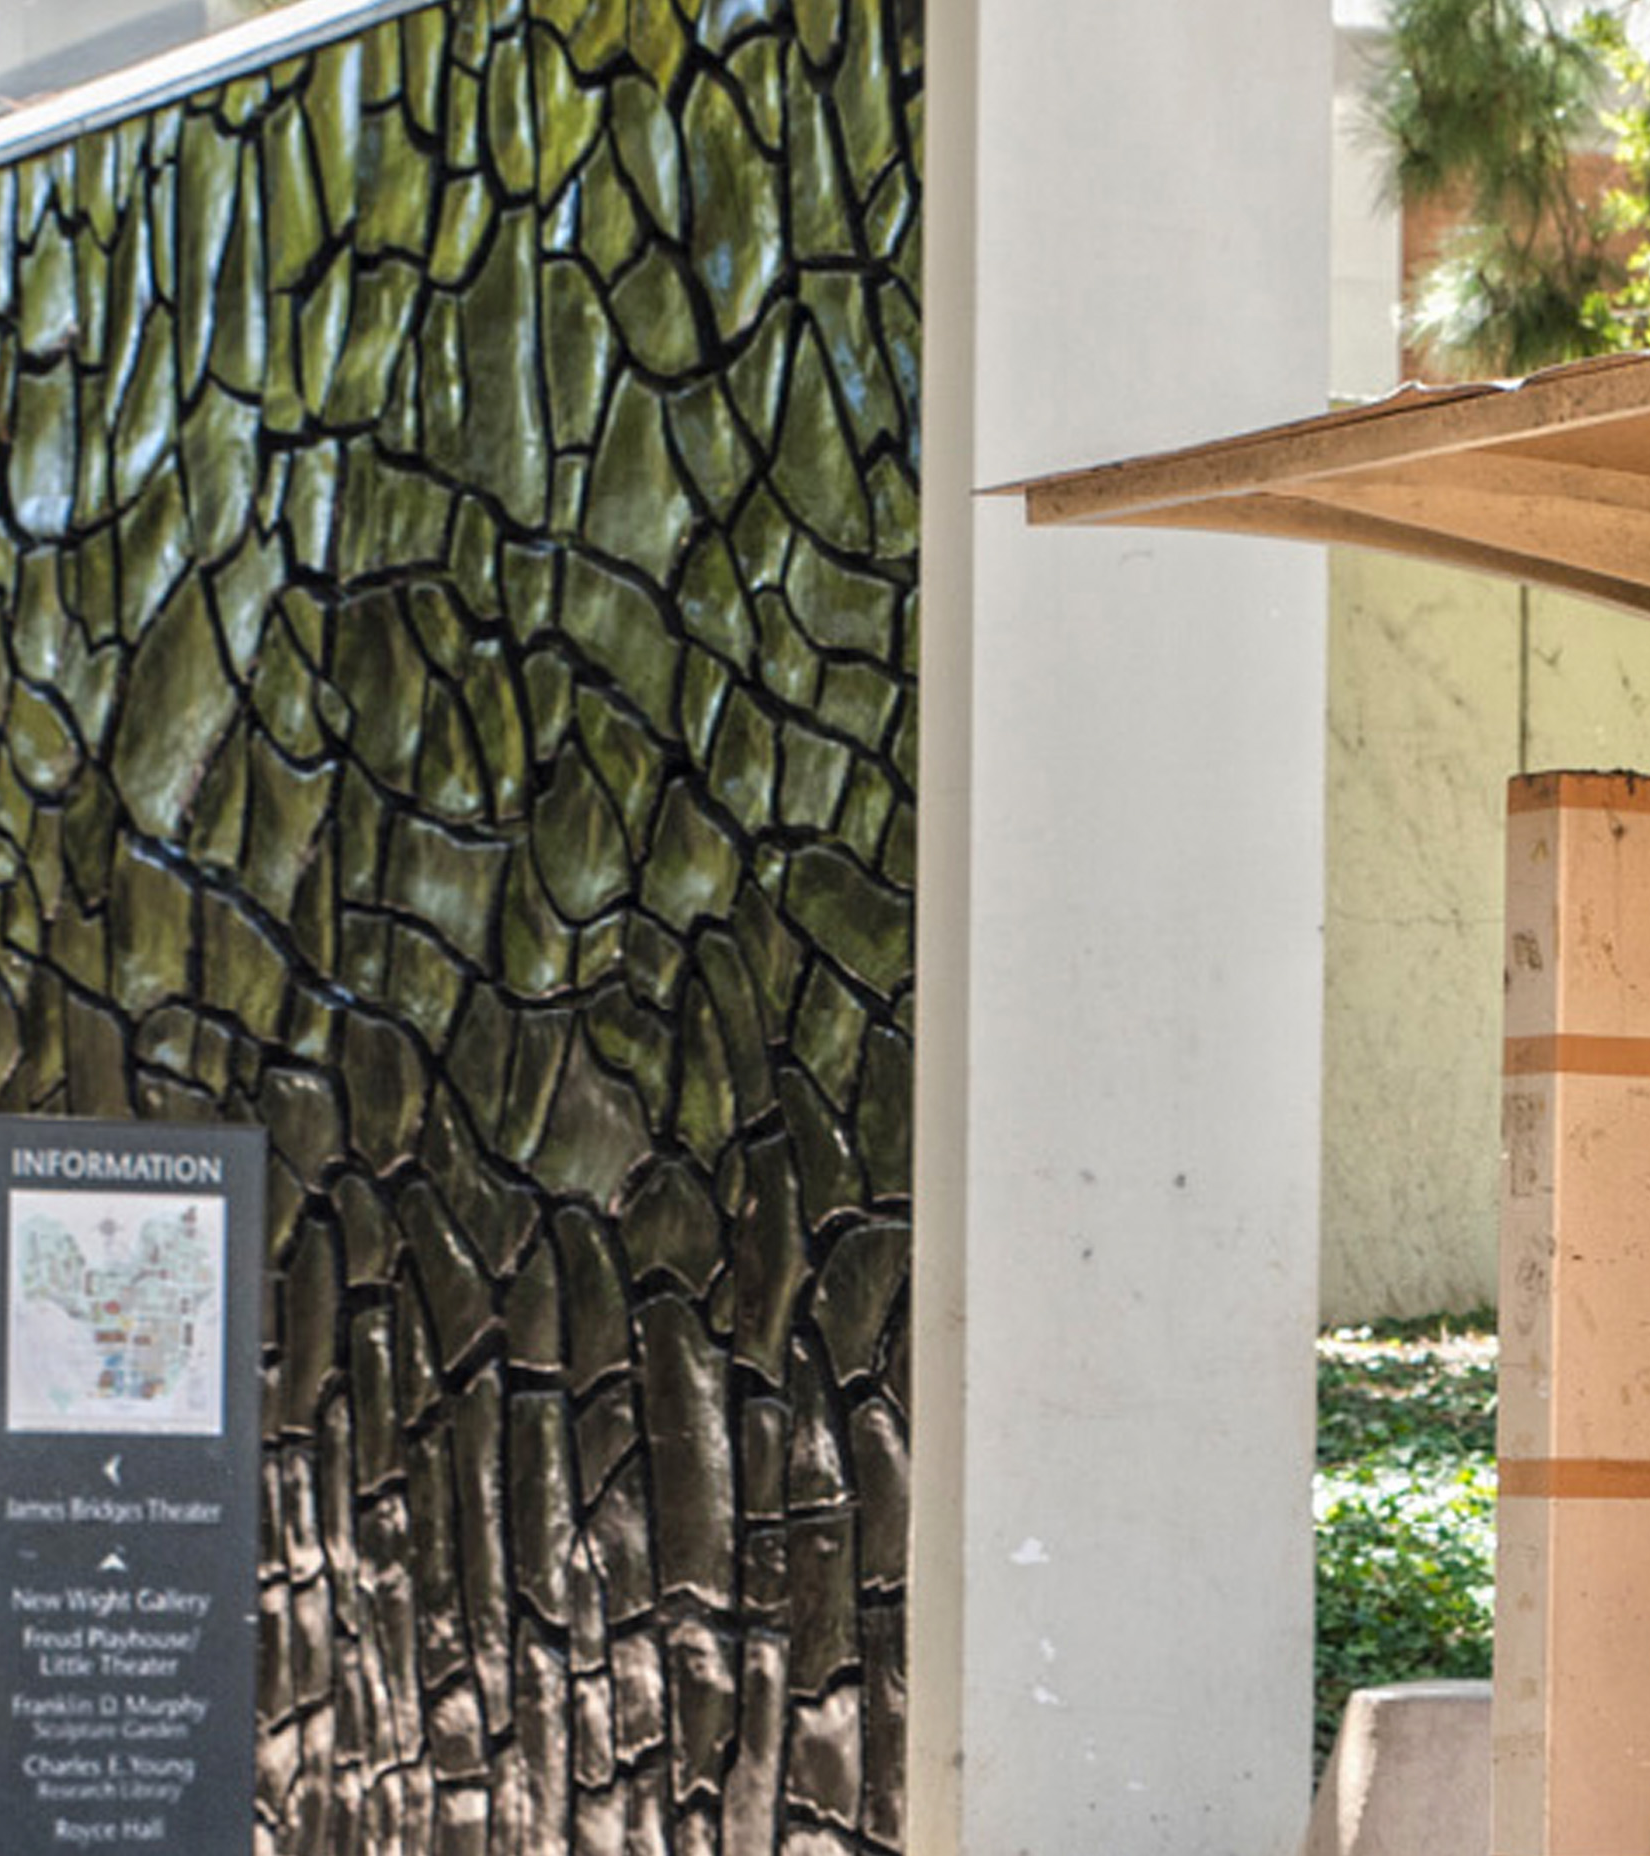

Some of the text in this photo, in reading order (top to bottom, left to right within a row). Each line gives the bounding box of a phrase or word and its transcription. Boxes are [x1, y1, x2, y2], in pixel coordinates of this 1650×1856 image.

[10, 1148, 223, 1184] INFORMATION
[7, 1498, 222, 1523] James Bridges Theater
[11, 1588, 212, 1616] New Wight Gallery
[23, 1626, 82, 1649] Freud
[39, 1654, 179, 1677] Little Theater
[11, 1693, 94, 1717] Franklin
[123, 1693, 206, 1723] Murphy
[31, 1719, 188, 1743] Sculpture Garden
[22, 1754, 100, 1778] Charles
[129, 1755, 195, 1784] Young
[37, 1780, 182, 1805] Research Library
[54, 1818, 165, 1845] Royce Hall
